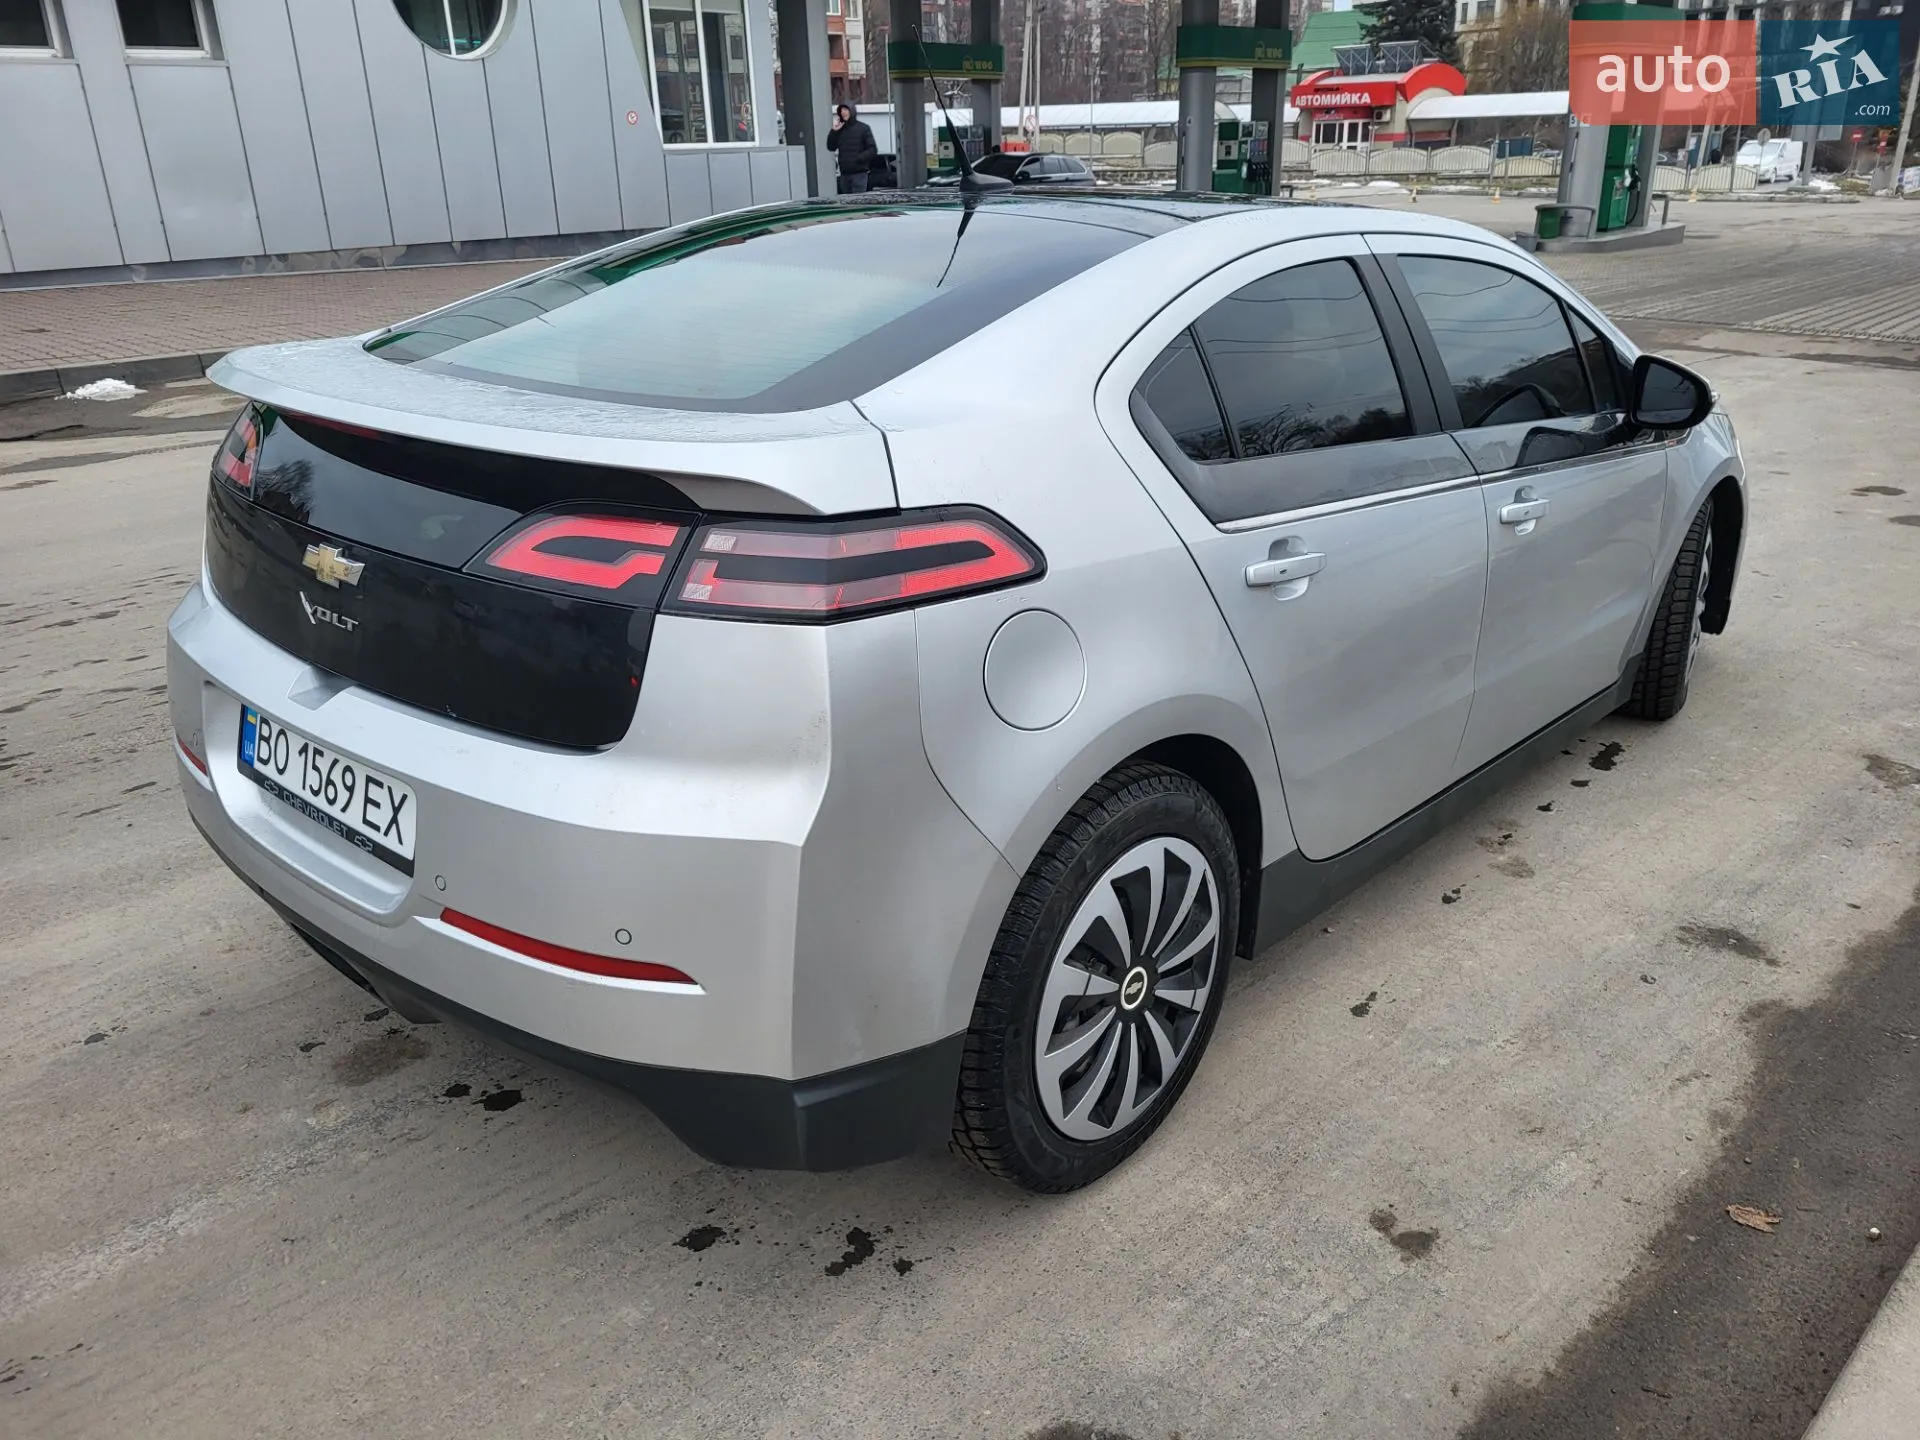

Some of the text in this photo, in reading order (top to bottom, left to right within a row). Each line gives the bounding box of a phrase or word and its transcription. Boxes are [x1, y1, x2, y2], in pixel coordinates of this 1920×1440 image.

[1295, 92, 1371, 106] АВТОМИЙКА
[299, 590, 360, 632] VOLT
[244, 740, 254, 756] UA
[257, 716, 408, 846] BO 1569 EX
[283, 790, 349, 840] CHEVROLET
